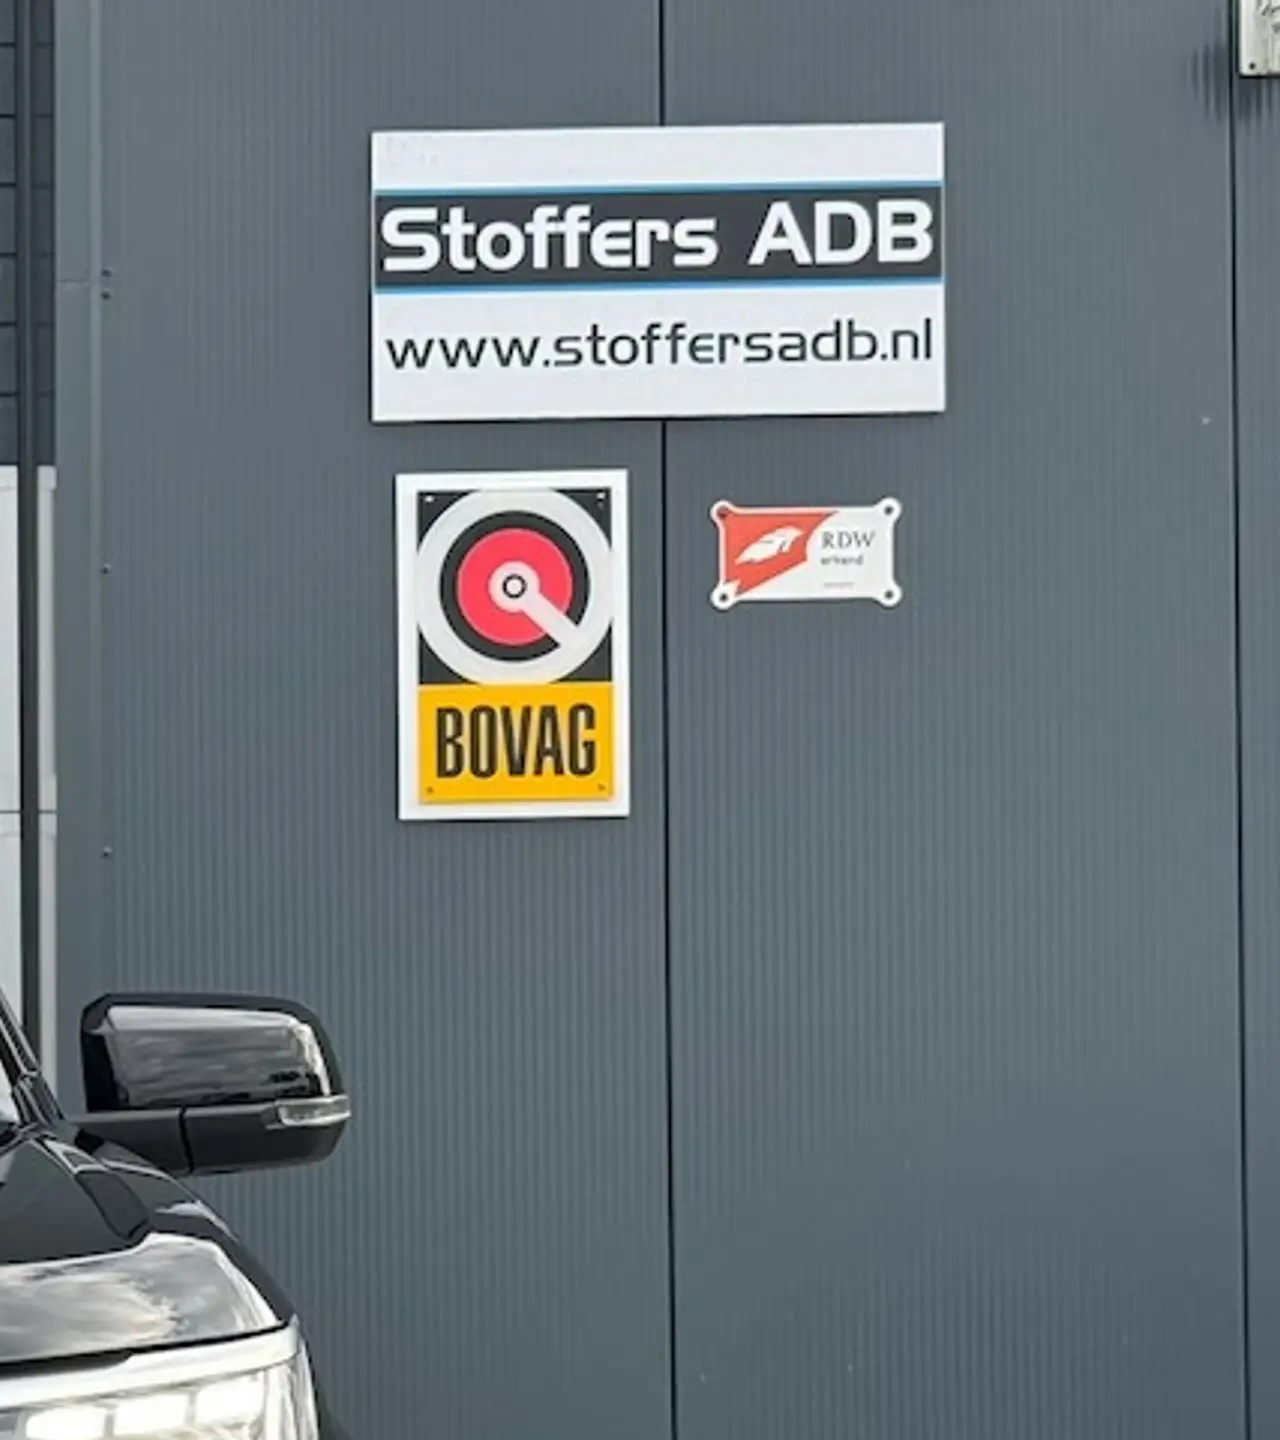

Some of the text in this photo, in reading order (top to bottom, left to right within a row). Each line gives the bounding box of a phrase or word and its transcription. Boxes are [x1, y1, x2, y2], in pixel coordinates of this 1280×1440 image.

[380, 199, 935, 272] Stoffers ADB
[386, 318, 933, 370] www.stoffersadb.nl
[820, 531, 875, 549] RDW
[436, 703, 597, 780] BOVAG
